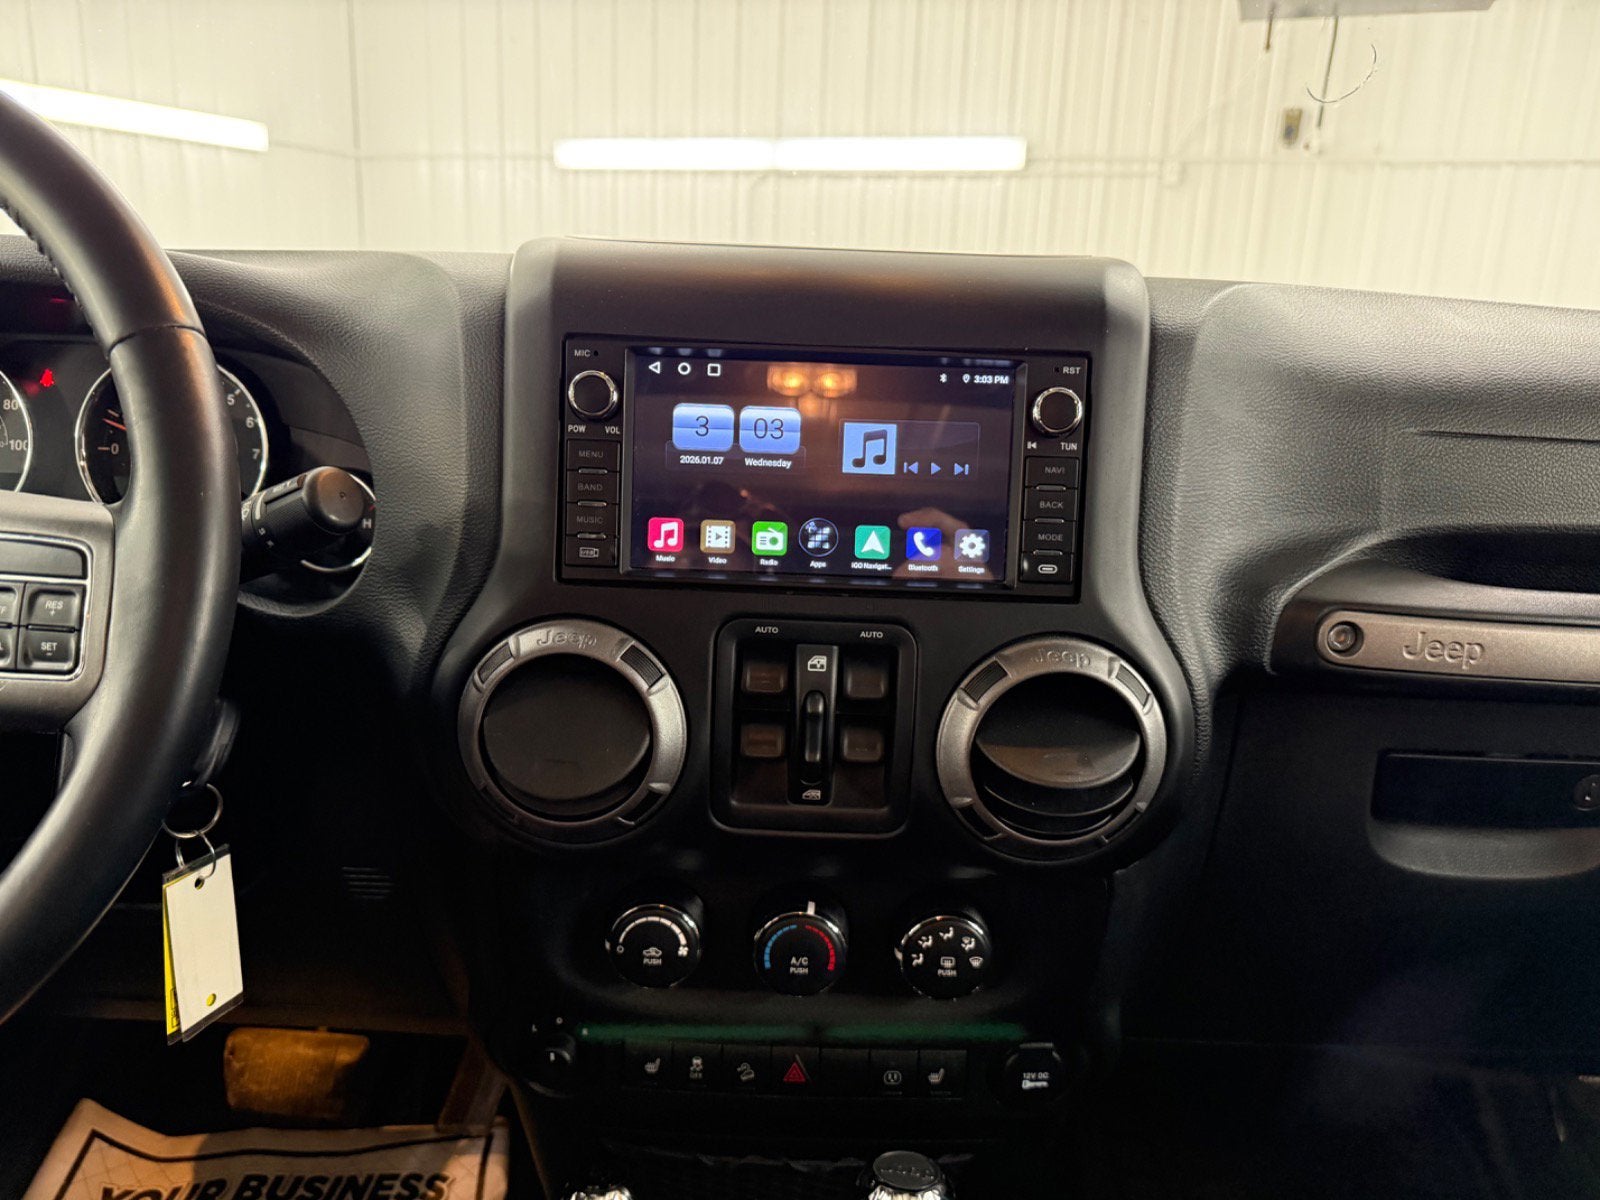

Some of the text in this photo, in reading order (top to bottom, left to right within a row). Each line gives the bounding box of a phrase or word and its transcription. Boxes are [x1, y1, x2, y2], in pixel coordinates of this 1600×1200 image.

[574, 349, 591, 357] MIC
[1062, 366, 1081, 375] RST
[973, 374, 1010, 385] 3:03 PM
[226, 393, 235, 406] 5
[2, 399, 20, 411] 80
[245, 416, 255, 429] 6
[567, 424, 587, 433] POW
[604, 425, 620, 434] VOL
[695, 415, 784, 440] 3 03
[110, 443, 120, 455] 0
[1060, 441, 1078, 451] TUN
[251, 447, 261, 460] 7
[578, 450, 604, 458] MENU
[744, 457, 793, 470] Wednesday
[1044, 466, 1066, 475] NAVI
[577, 482, 604, 492] BAND
[1039, 501, 1064, 510] BACK
[576, 515, 604, 525] MUSIC
[1037, 533, 1064, 542] MODE
[654, 554, 677, 563] Music
[708, 556, 728, 565] Video
[759, 558, 779, 567] Radio
[809, 560, 827, 569] Apps
[907, 564, 939, 572] Bluetooth
[957, 565, 986, 574] Settings
[45, 600, 65, 609] RES
[754, 626, 779, 634] AUTO
[536, 629, 597, 650] Jeep
[859, 631, 884, 639] AUTO
[40, 641, 58, 651] SET
[1401, 631, 1486, 670] Jeep
[642, 957, 662, 966] PUSH
[790, 956, 809, 966] A/C
[789, 967, 809, 975] PUSH
[937, 968, 957, 977] PUSH
[231, 1173, 450, 1200] BUSINESS
